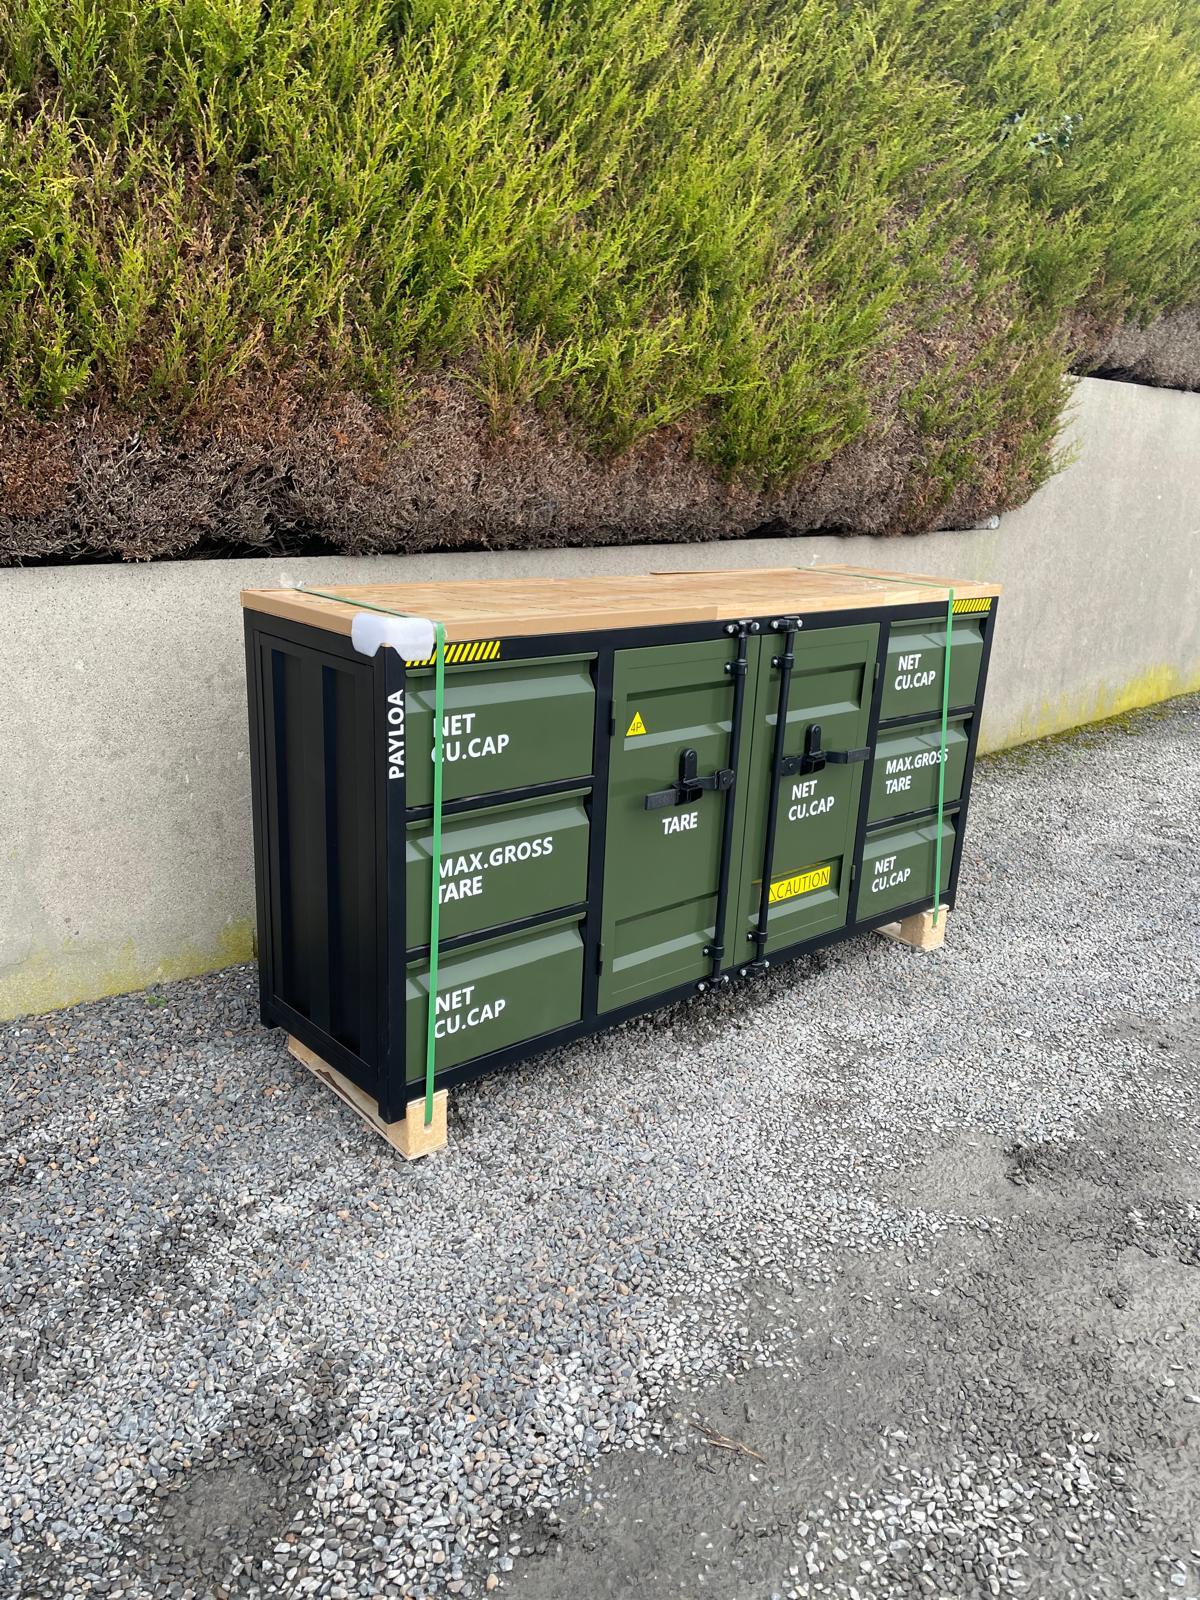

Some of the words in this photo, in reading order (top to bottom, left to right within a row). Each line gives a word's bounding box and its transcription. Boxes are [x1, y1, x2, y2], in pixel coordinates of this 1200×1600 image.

[897, 653, 922, 671] NET
[894, 671, 936, 690] CU.CAP
[387, 689, 404, 779] PAYLOA
[433, 713, 476, 738] NET
[791, 780, 818, 800] NET
[885, 776, 912, 794] TARE
[788, 796, 835, 821] CU.CAP
[662, 812, 699, 835] TARE
[438, 837, 553, 879] MAX.GROSS
[874, 856, 897, 875] NET
[437, 876, 483, 904] TARE
[776, 870, 829, 899] CAUTION
[871, 868, 911, 893] CU.CAP
[435, 986, 475, 1015] NET
[434, 999, 506, 1039] CU.CAP
